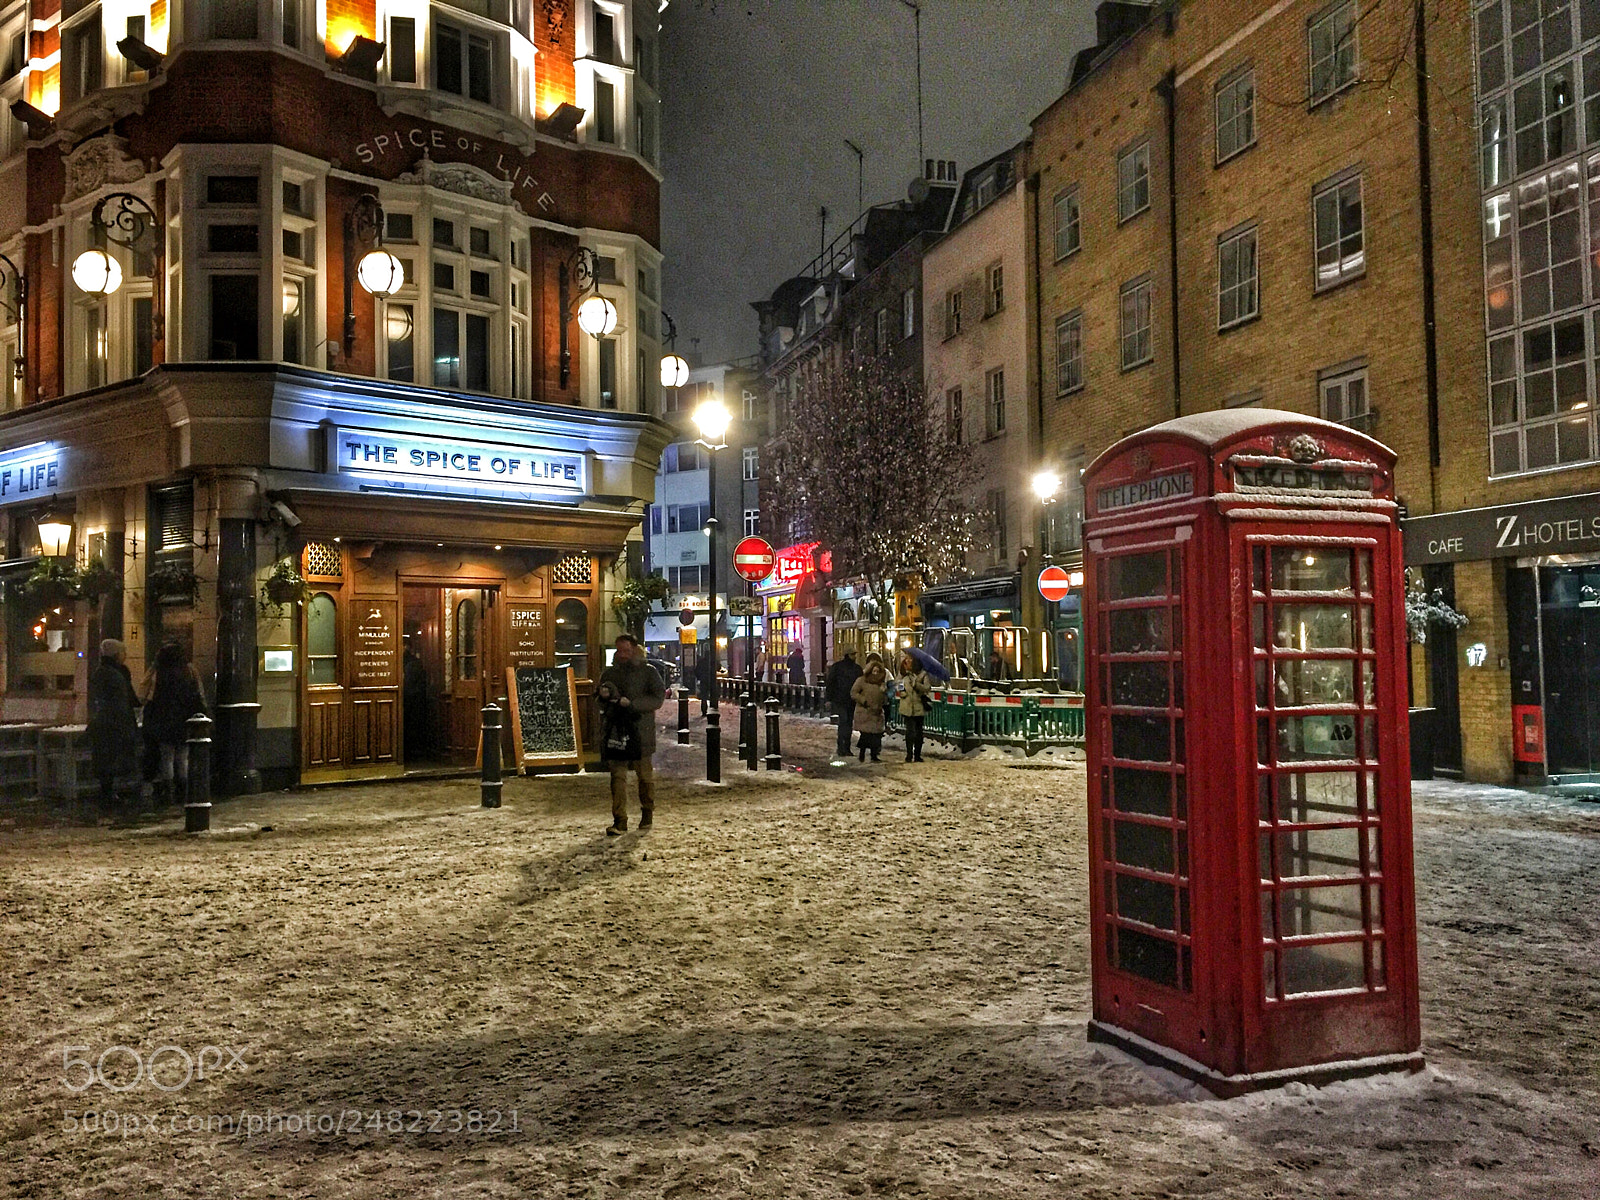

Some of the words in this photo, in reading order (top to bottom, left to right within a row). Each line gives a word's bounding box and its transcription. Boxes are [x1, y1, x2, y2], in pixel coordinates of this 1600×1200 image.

[356, 128, 446, 163] SPICE
[457, 137, 484, 153] OF
[496, 153, 555, 212] LIFE
[19, 461, 59, 493] LIFE
[346, 442, 398, 464] THE
[409, 449, 481, 472] SPICE
[490, 457, 521, 475] OF
[530, 461, 577, 481] LIFE
[1103, 472, 1191, 509] TELEPHONE
[1428, 537, 1464, 555] CAFE
[1496, 514, 1520, 548] Z
[1524, 517, 1600, 545] HOTELS
[516, 611, 541, 620] SPICE
